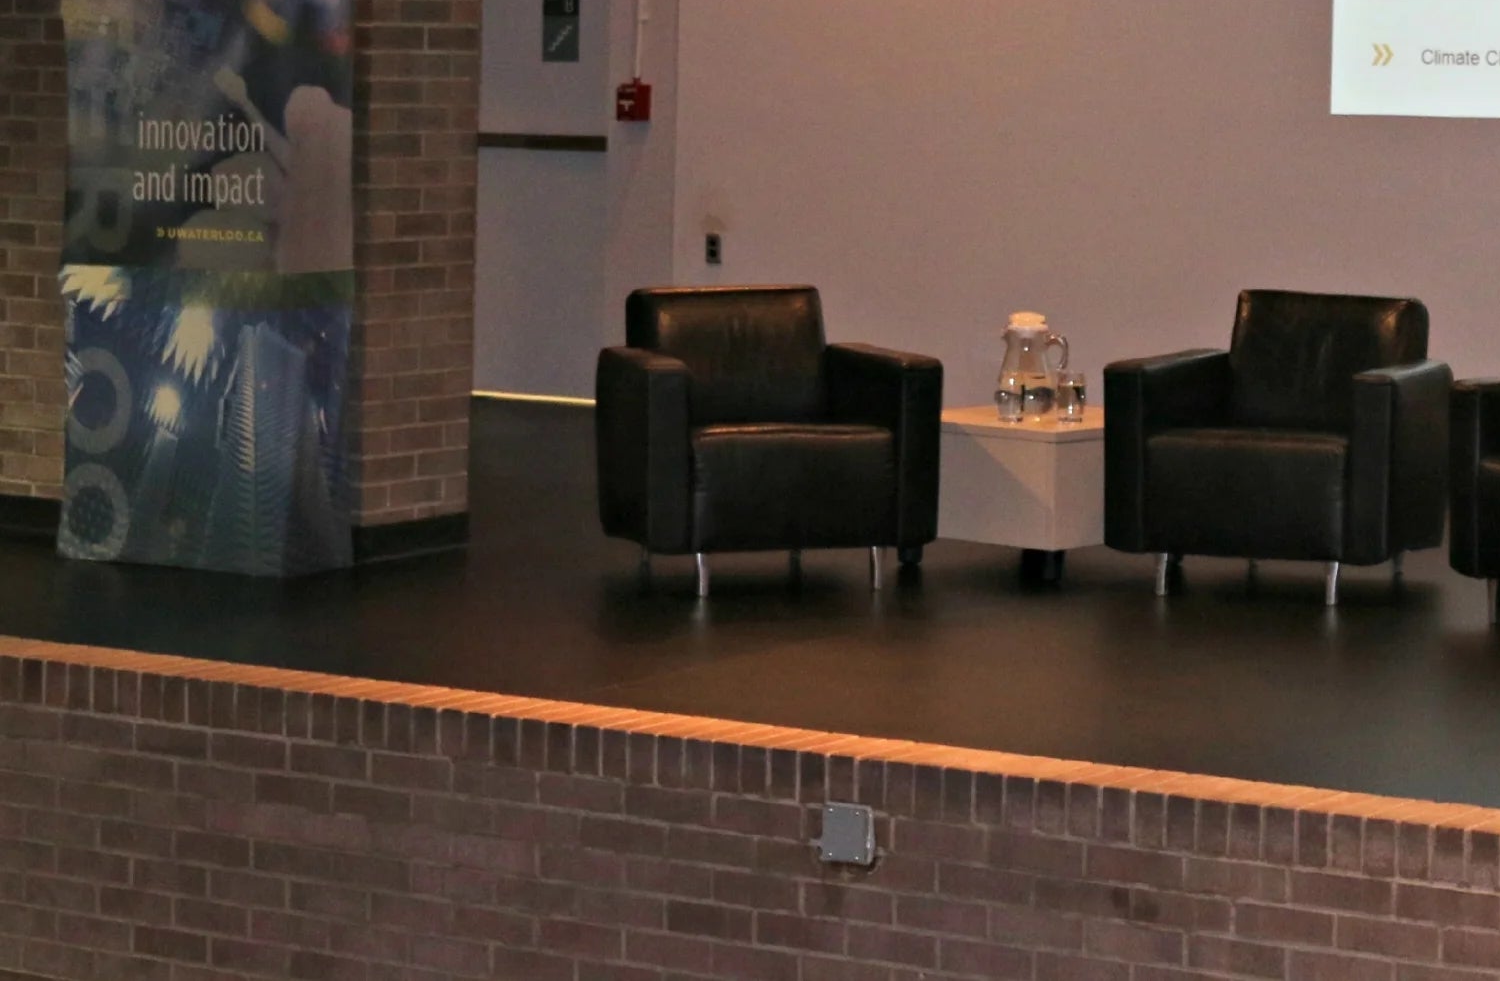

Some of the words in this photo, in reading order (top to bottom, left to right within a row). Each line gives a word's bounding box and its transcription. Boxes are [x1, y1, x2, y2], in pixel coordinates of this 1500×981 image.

[1421, 48, 1480, 67] Climate
[139, 111, 265, 152] innovation
[133, 166, 175, 202] and
[183, 165, 265, 209] impact
[168, 227, 264, 242] UWATERLOO.CA
